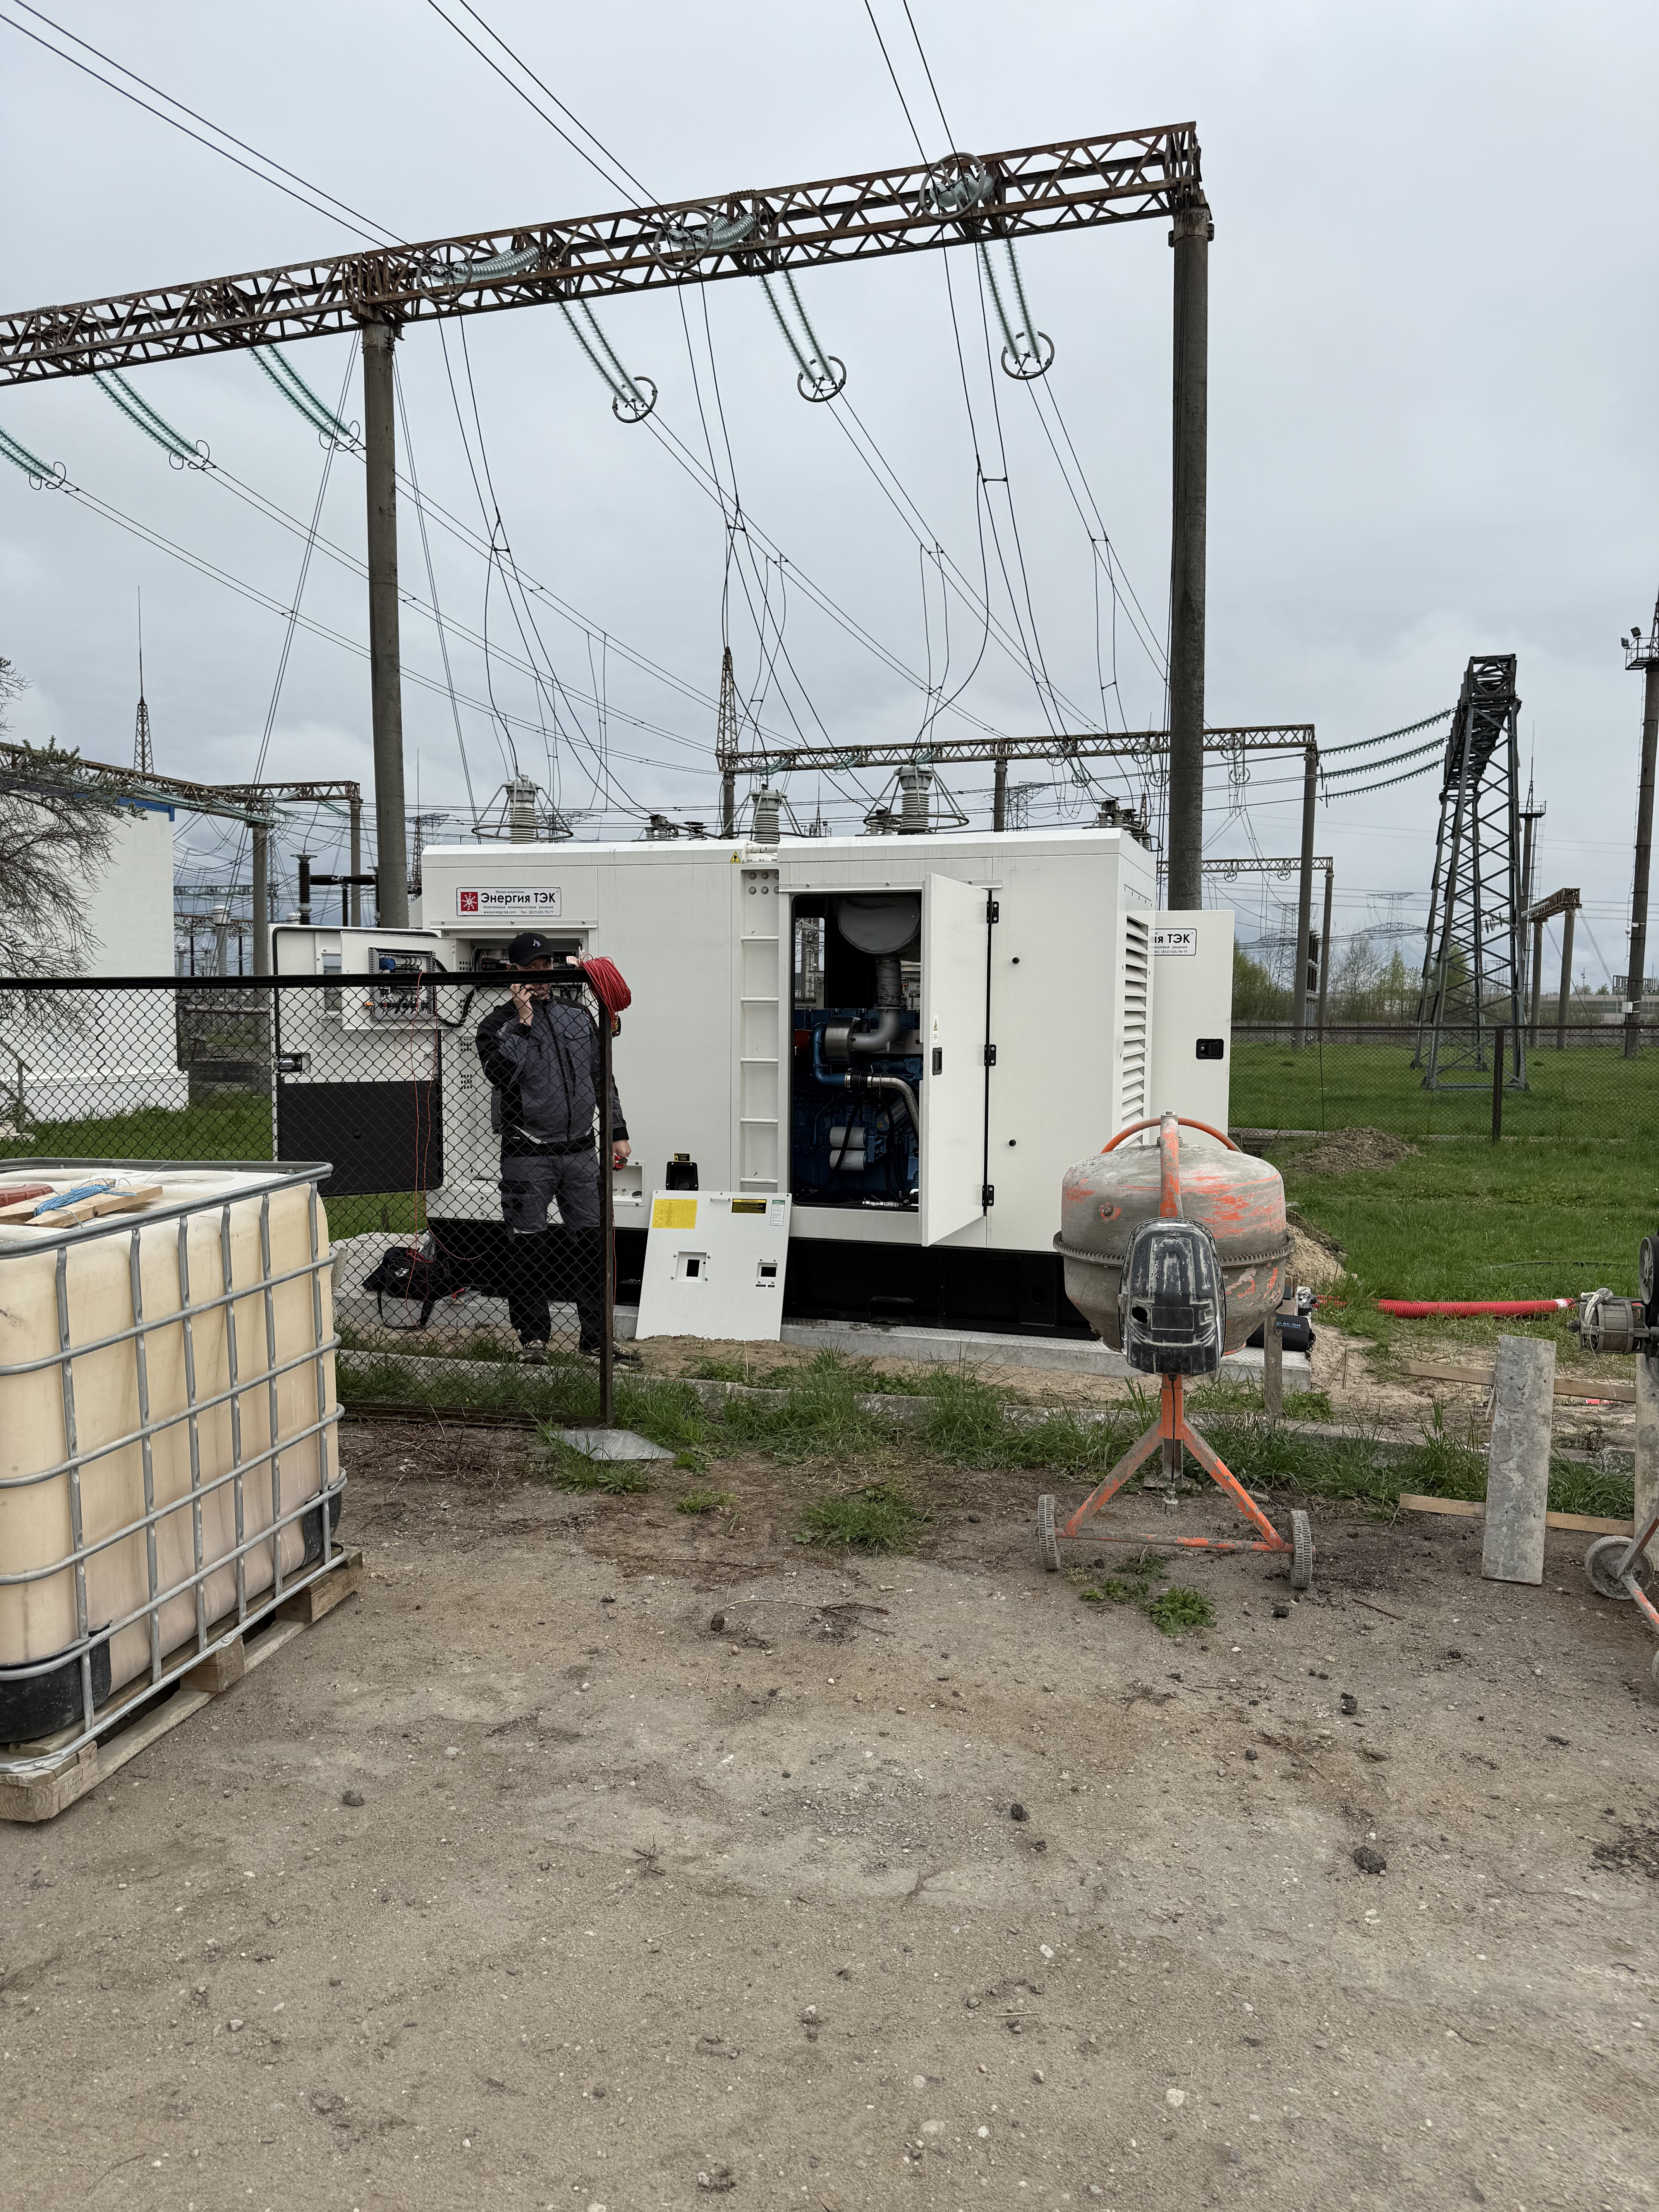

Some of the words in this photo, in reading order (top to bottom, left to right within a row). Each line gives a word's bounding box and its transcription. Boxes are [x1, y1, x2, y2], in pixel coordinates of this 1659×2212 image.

[481, 893, 530, 905] Энергия
[534, 892, 556, 903] ТЭК
[1167, 934, 1190, 943] ТЭК
